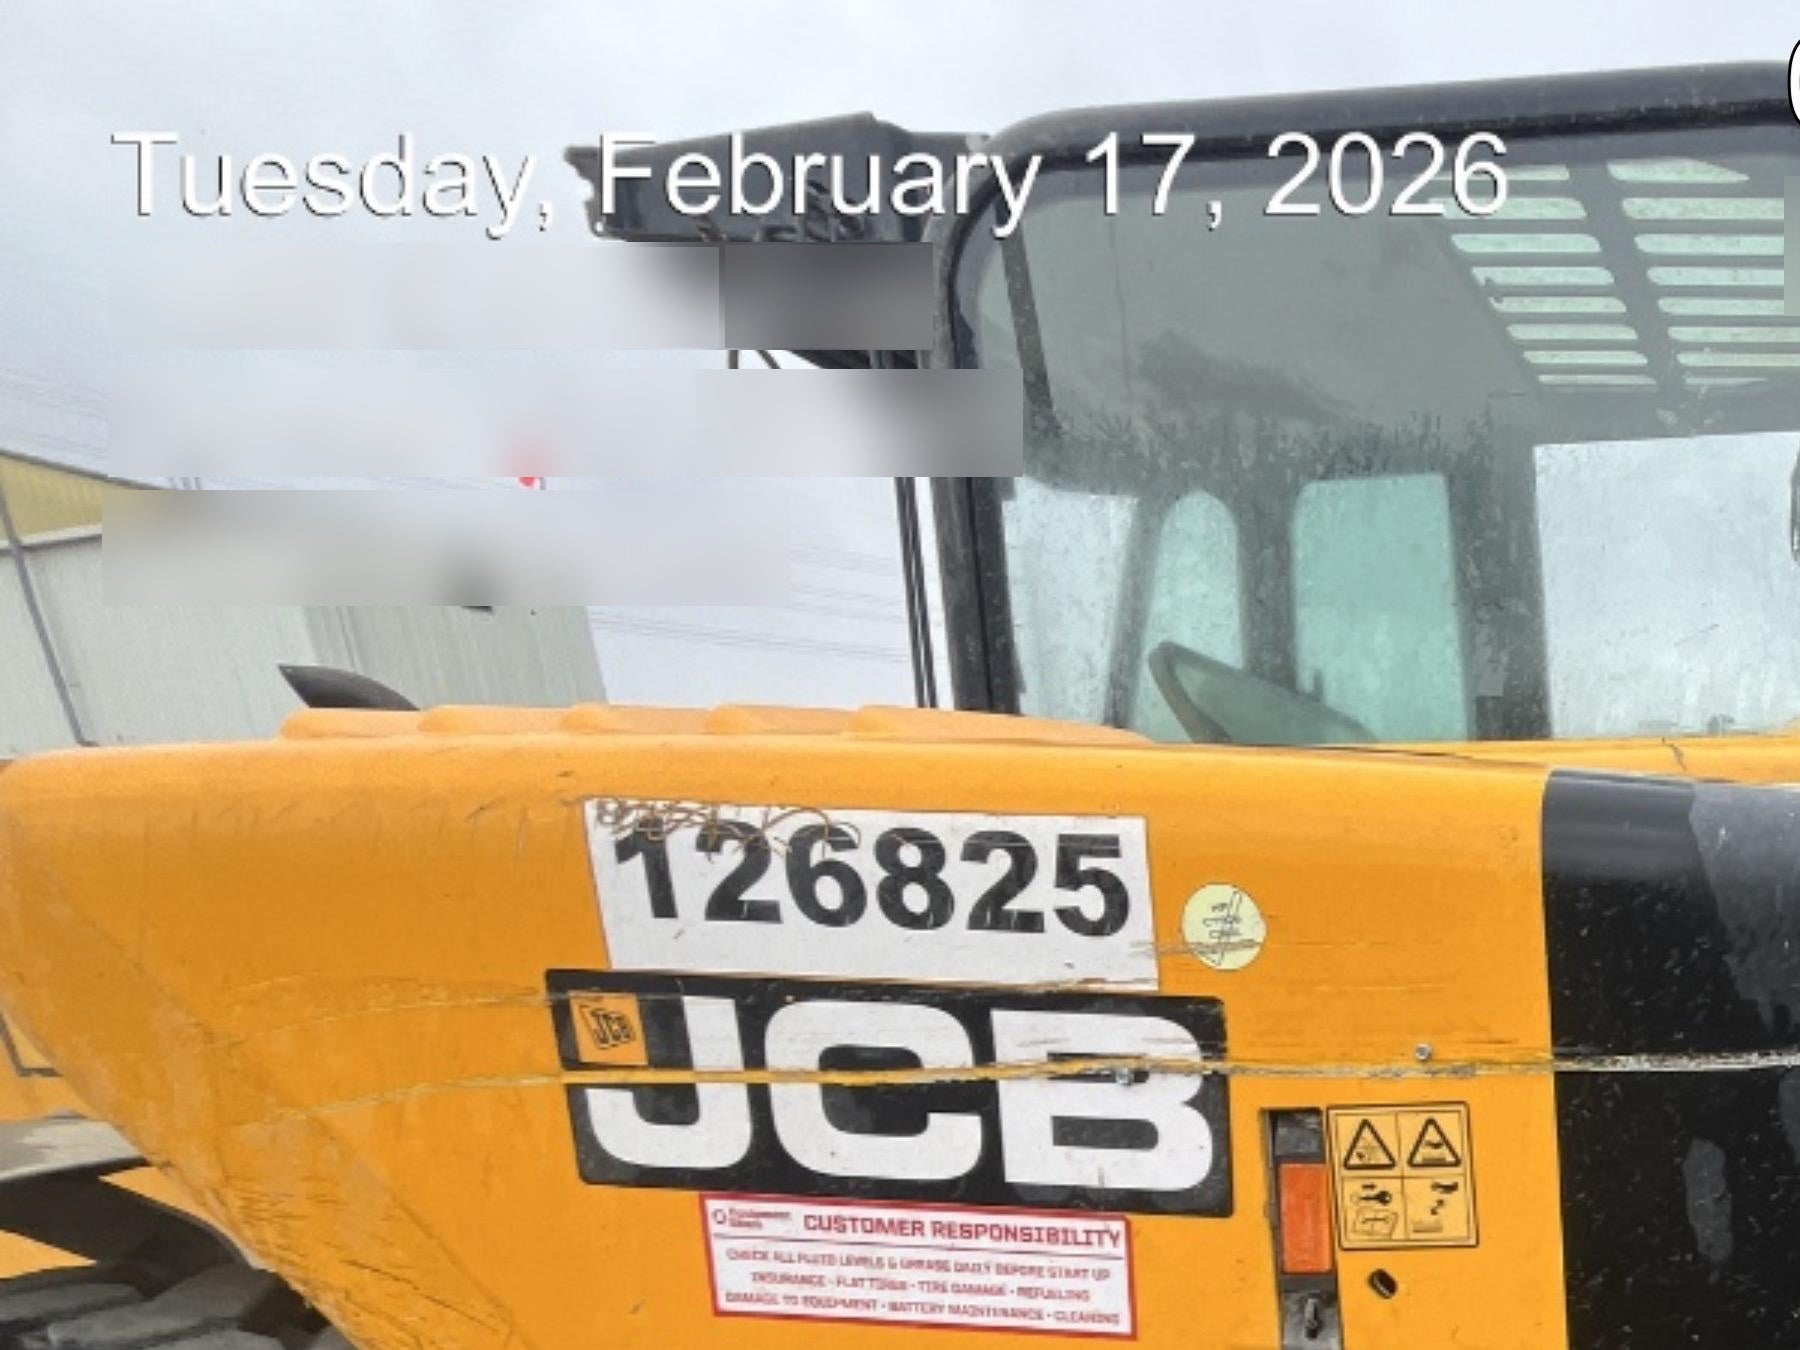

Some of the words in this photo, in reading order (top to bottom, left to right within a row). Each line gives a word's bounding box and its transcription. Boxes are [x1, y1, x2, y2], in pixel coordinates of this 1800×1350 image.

[614, 815, 1130, 939] 126825
[584, 994, 1214, 1192] JCB
[773, 1250, 796, 1264] ALL
[804, 1214, 925, 1236] CUSTOMER
[930, 1220, 1121, 1247] RESPONSIBILITY
